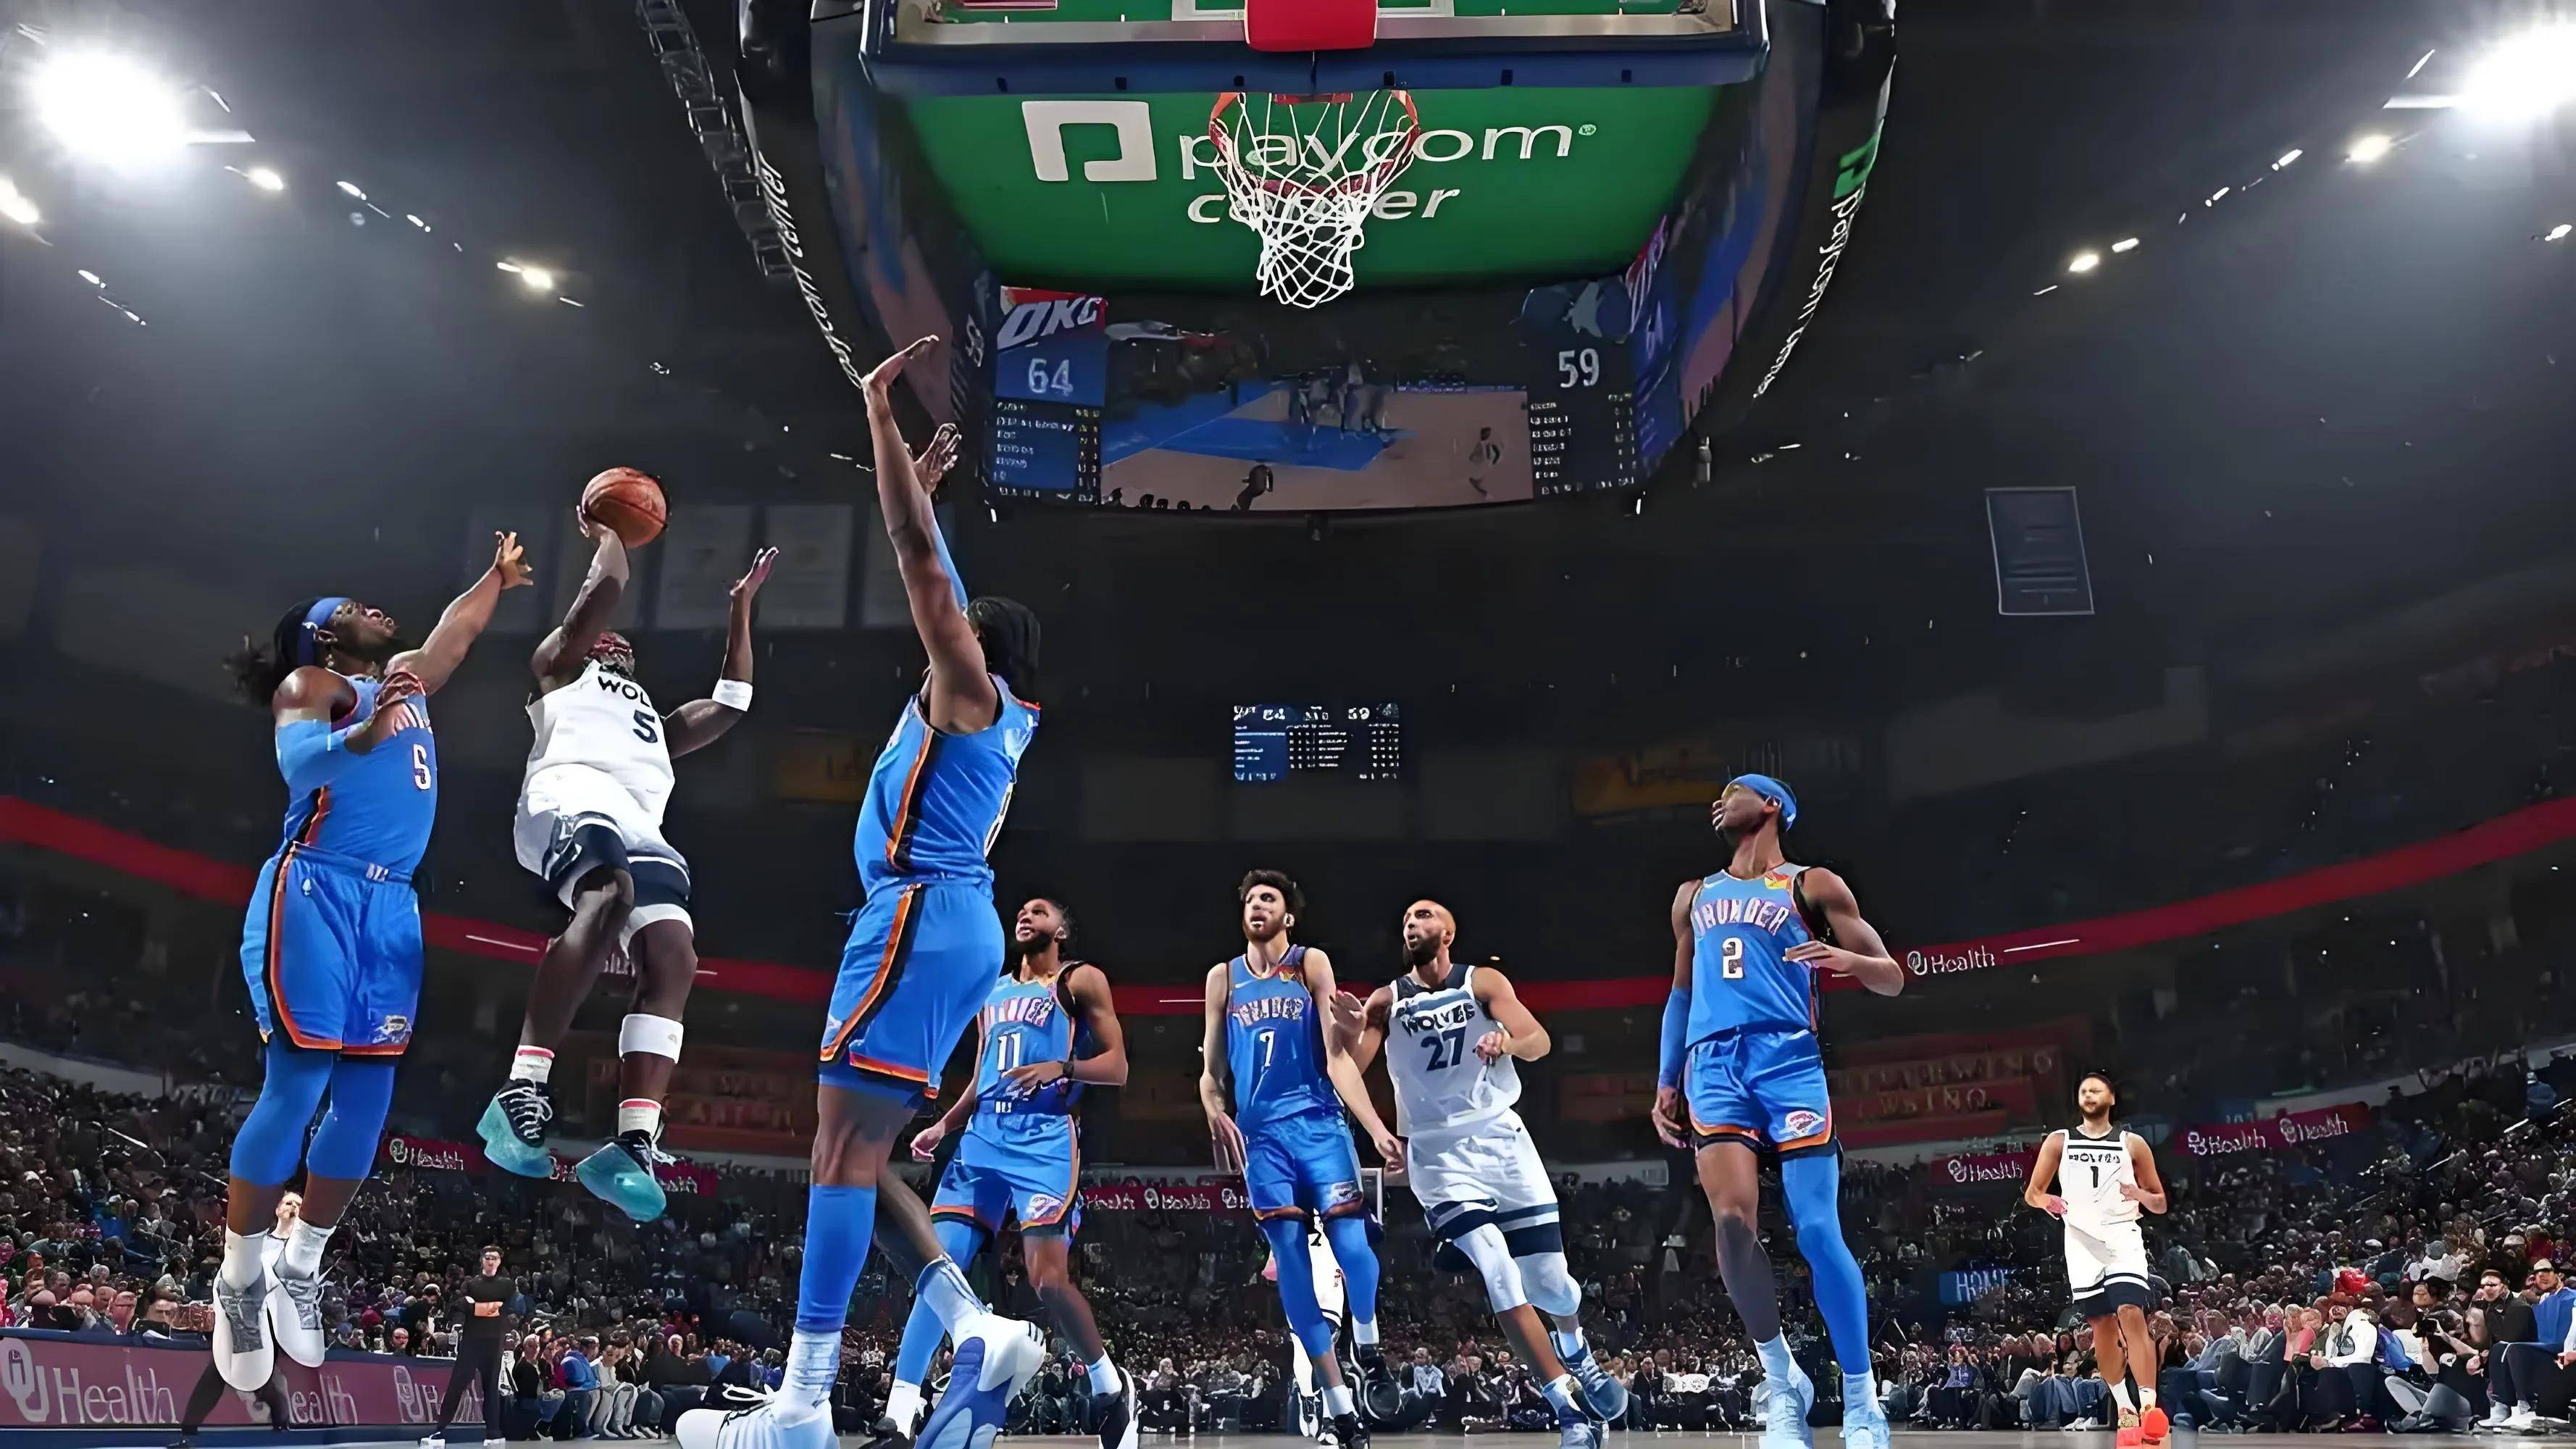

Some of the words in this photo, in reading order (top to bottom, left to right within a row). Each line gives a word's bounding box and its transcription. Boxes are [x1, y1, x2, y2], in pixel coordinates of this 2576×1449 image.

[1797, 185, 1862, 320] paycom
[997, 296, 1104, 351] OKC
[1028, 358, 1074, 396] 64
[1558, 348, 1600, 388] 59
[632, 709, 658, 743] 5
[413, 743, 432, 790] 5
[1694, 898, 1790, 937] THUNDER
[1722, 938, 1743, 979] 2
[1931, 945, 1996, 974] Health
[997, 1032, 1021, 1071] 11
[1259, 1031, 1275, 1068] 7
[1421, 1026, 1466, 1072] 27
[2090, 1166, 2099, 1188] 1
[53, 1364, 180, 1424] Health
[290, 1373, 358, 1426] ealth
